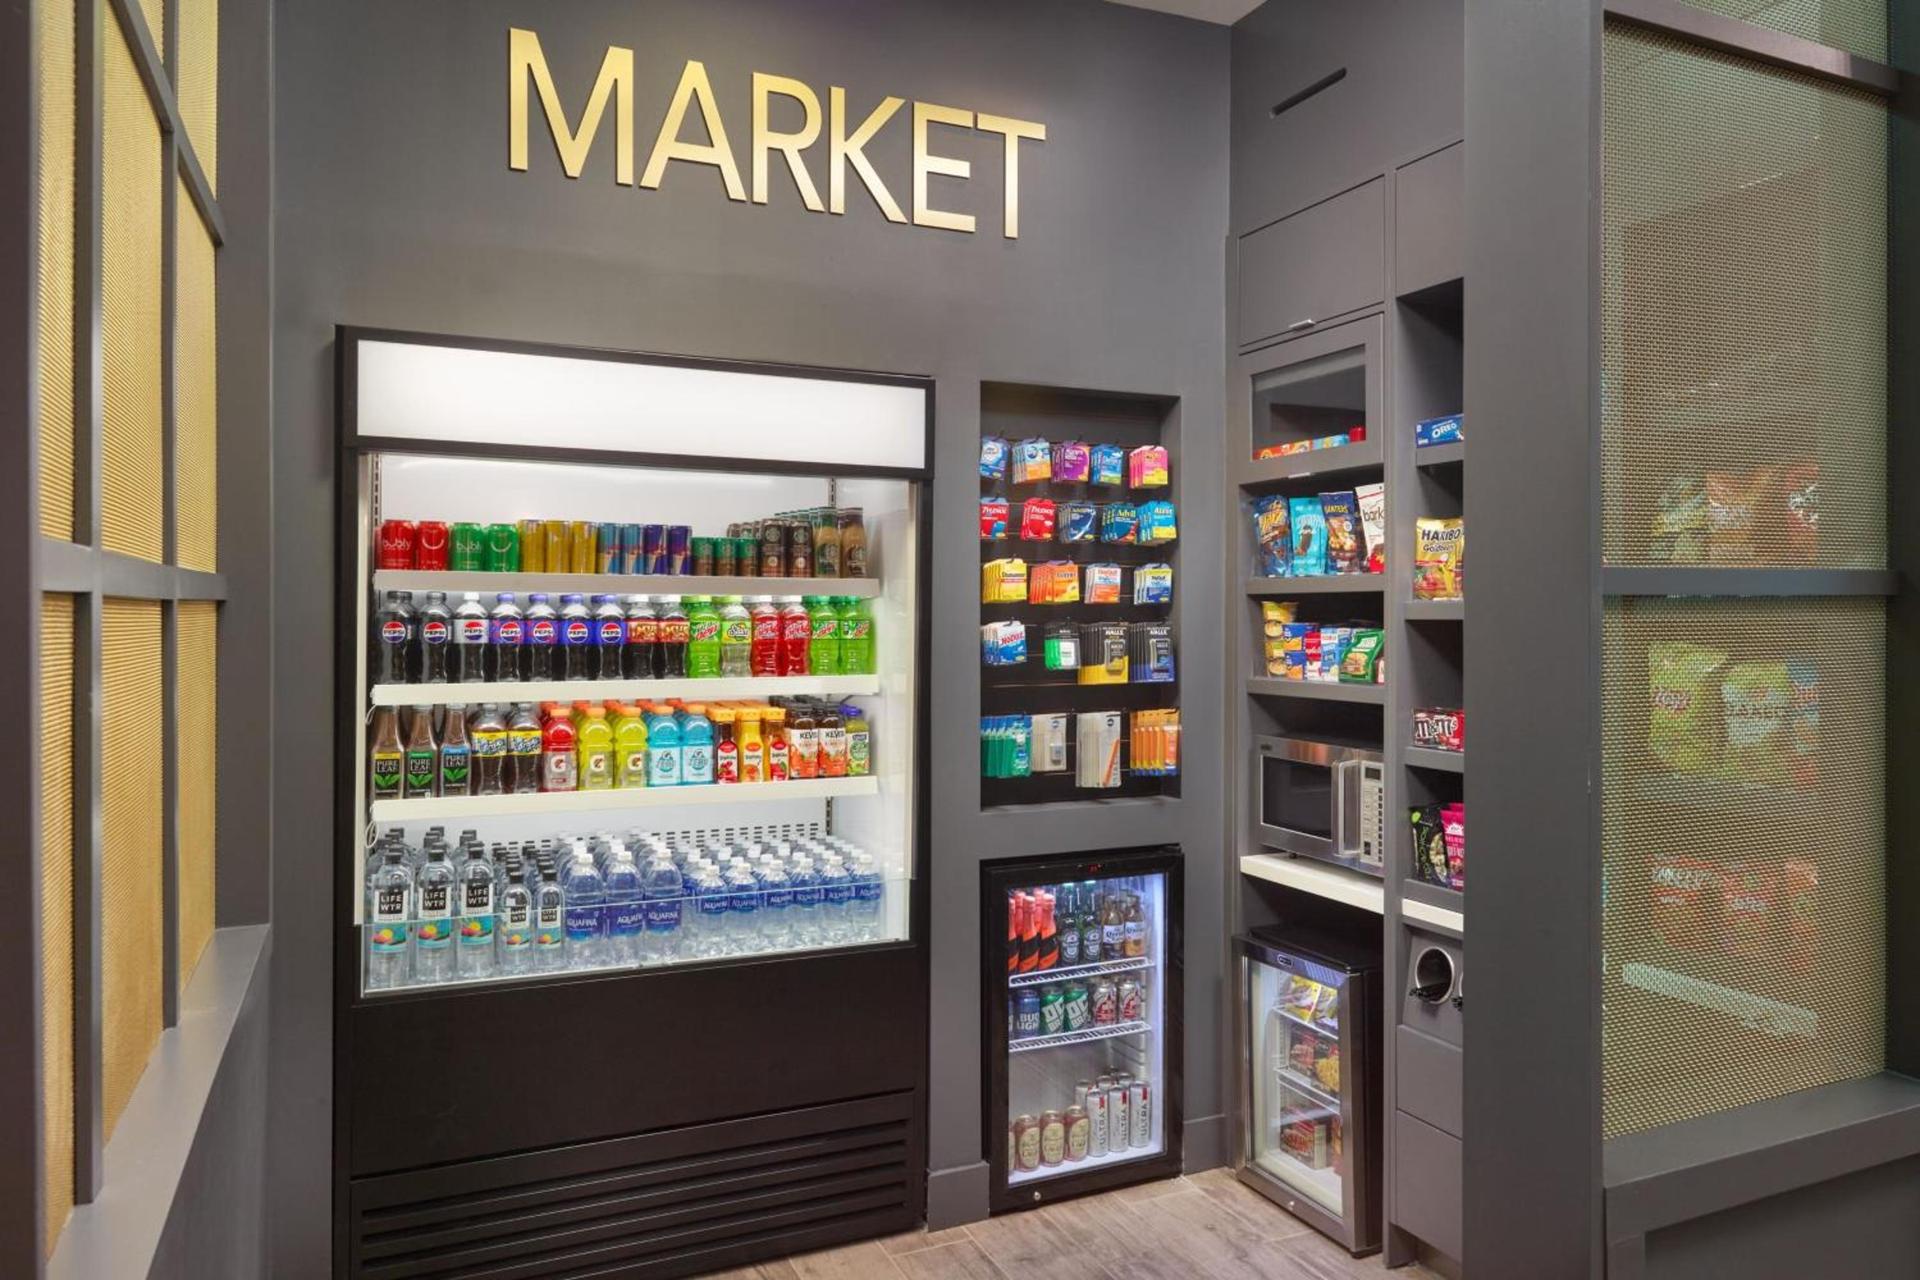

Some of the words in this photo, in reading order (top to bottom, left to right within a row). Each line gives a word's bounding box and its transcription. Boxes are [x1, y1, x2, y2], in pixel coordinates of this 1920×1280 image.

[509, 27, 1046, 239] MARKET
[1431, 423, 1457, 438] OREO
[1422, 528, 1460, 541] HARIBO
[410, 759, 431, 767] PURE
[424, 891, 446, 899] LIFE
[468, 887, 488, 897] LIFE
[381, 894, 402, 902] LIFE
[467, 895, 488, 905] WTR
[380, 902, 402, 911] WTR
[424, 899, 444, 908] WTR
[1140, 1104, 1148, 1137] ULTRA
